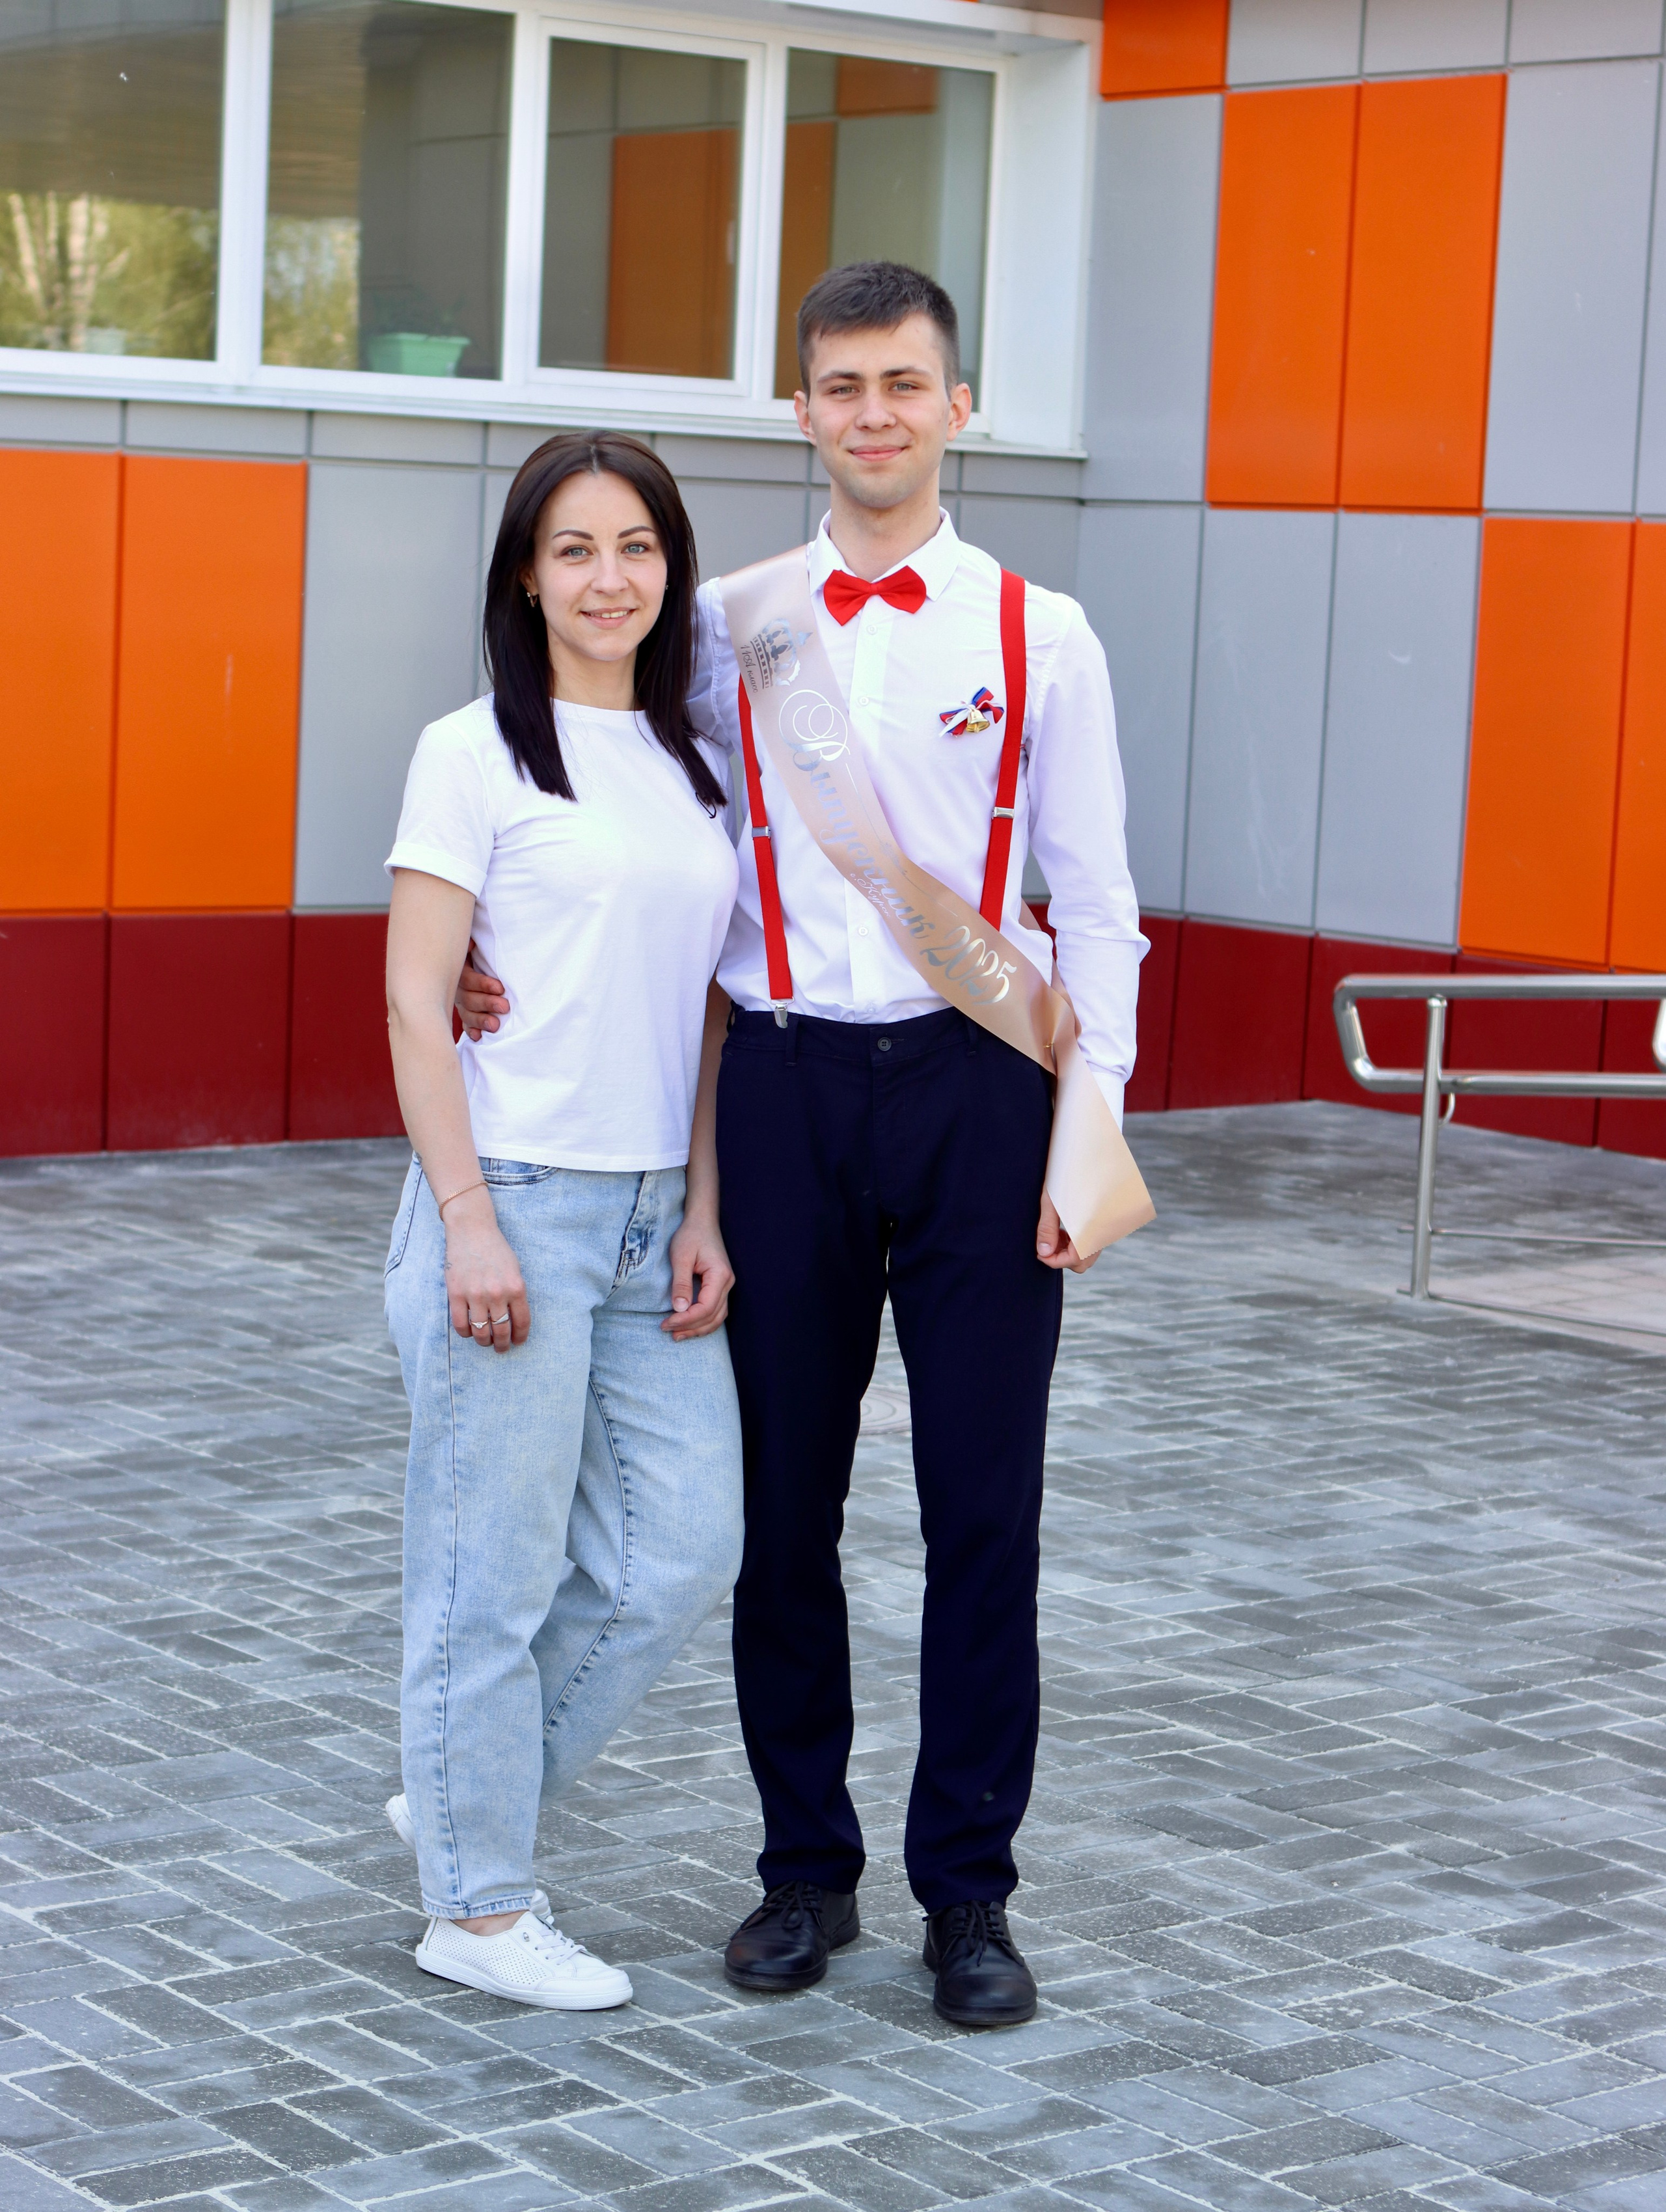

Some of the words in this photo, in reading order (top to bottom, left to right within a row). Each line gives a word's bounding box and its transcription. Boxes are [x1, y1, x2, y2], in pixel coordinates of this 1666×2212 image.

[747, 670, 758, 693] класс
[779, 689, 936, 939] Выпускник
[919, 925, 1017, 1005] 2025
[850, 873, 857, 881] г.
[857, 879, 891, 918] Курск
